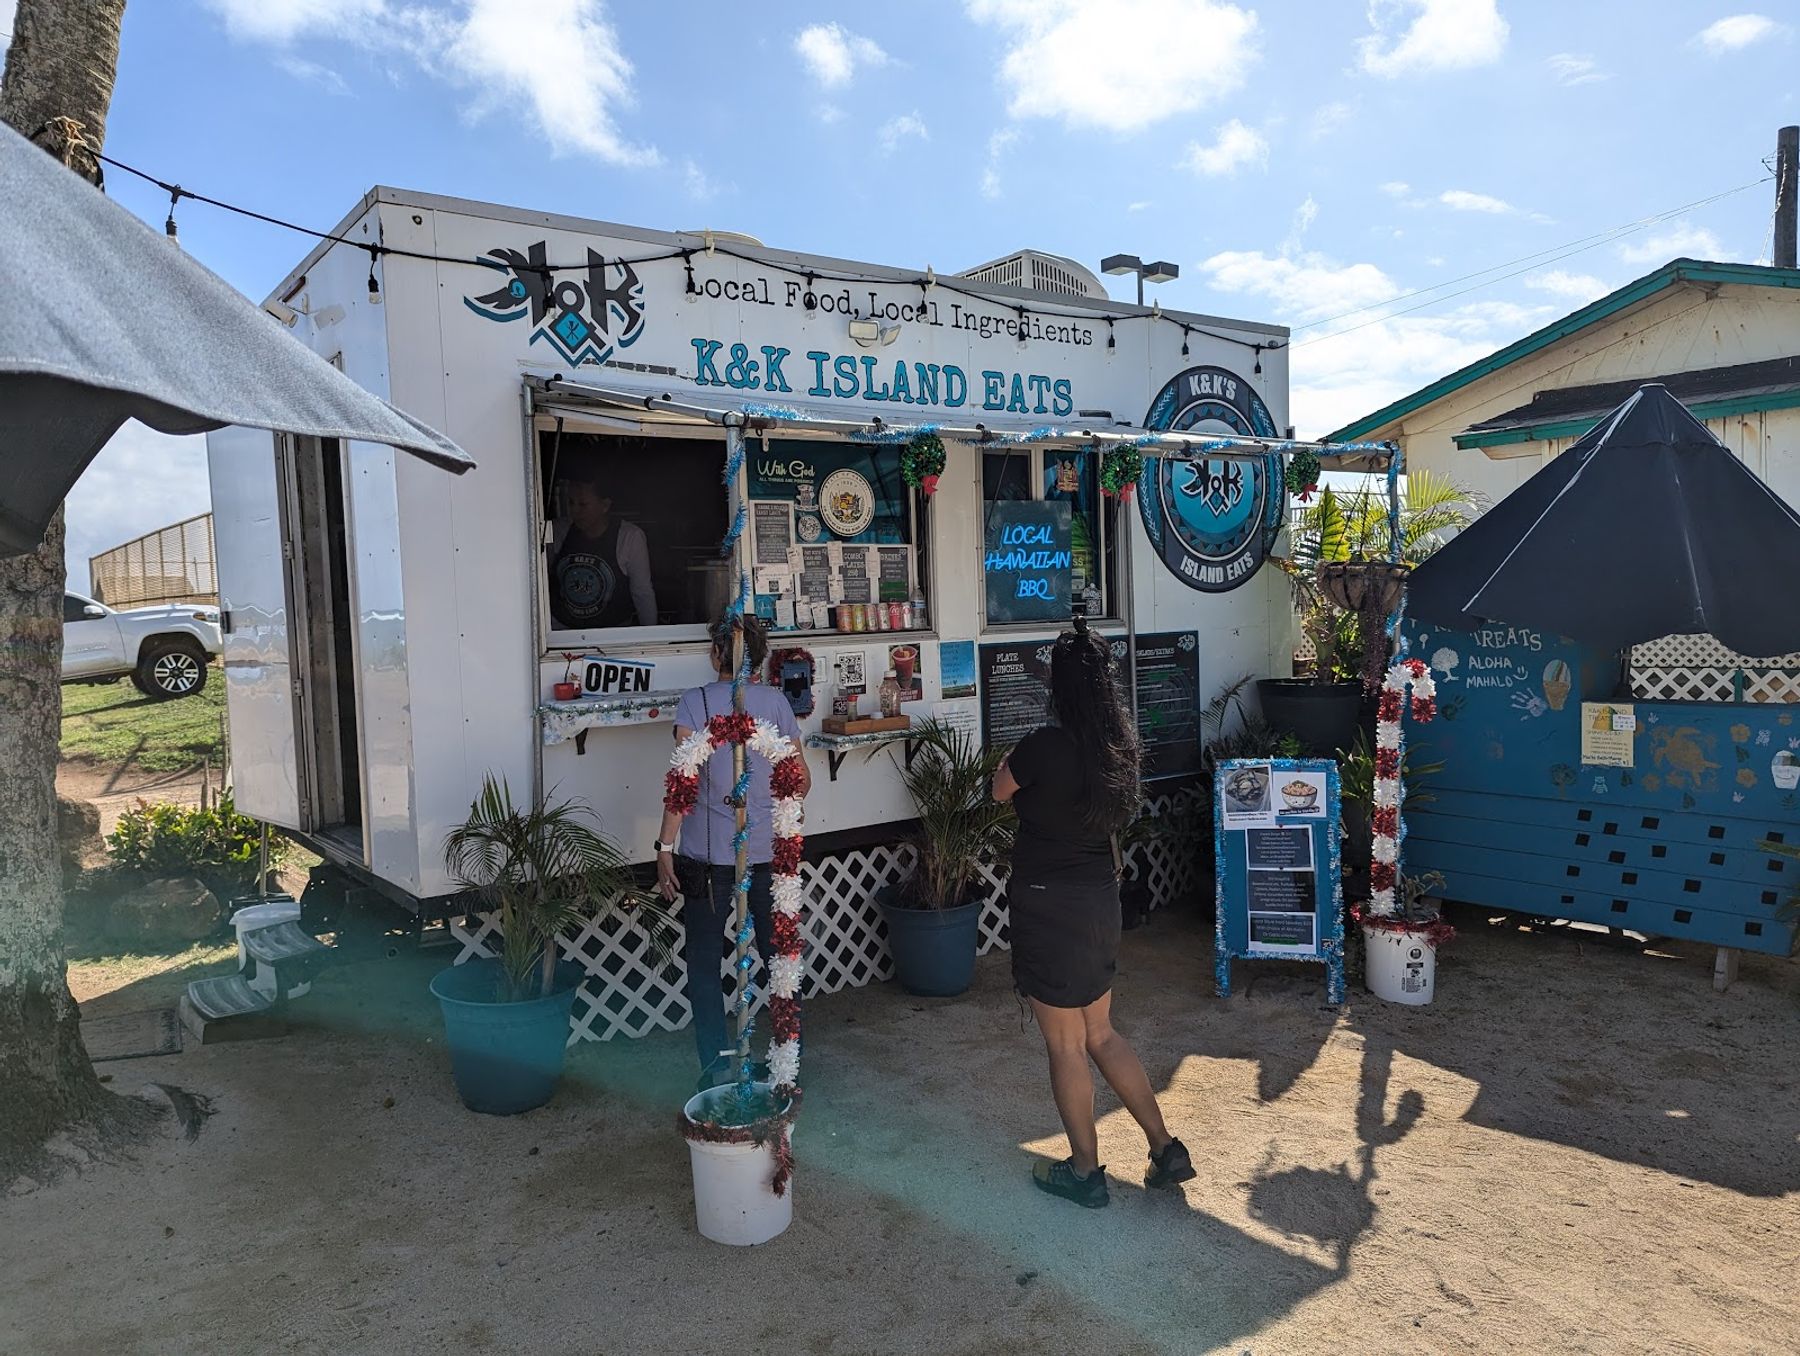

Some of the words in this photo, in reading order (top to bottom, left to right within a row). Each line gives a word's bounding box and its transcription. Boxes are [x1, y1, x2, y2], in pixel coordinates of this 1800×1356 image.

[684, 264, 775, 307] Local
[784, 282, 859, 319] Food,
[868, 292, 943, 327] Local
[950, 304, 1093, 346] Ingredients
[691, 338, 793, 392] K&K
[806, 351, 967, 407] ISLAND
[982, 370, 1074, 417] EATS
[1189, 373, 1237, 400] K&K'S
[757, 458, 787, 476] With
[788, 460, 816, 478] God
[1002, 525, 1054, 545] LOCAL
[985, 549, 1071, 571] HAWAIIAN
[1180, 555, 1224, 583] ISLAND
[1226, 551, 1254, 580] EATS
[1017, 579, 1055, 600] BBQ
[995, 652, 1019, 662] PLATE
[1468, 655, 1512, 669] ALOHA
[585, 662, 651, 693] OPEN
[992, 663, 1025, 674] LUNCHES
[1466, 675, 1514, 689] MAHALO
